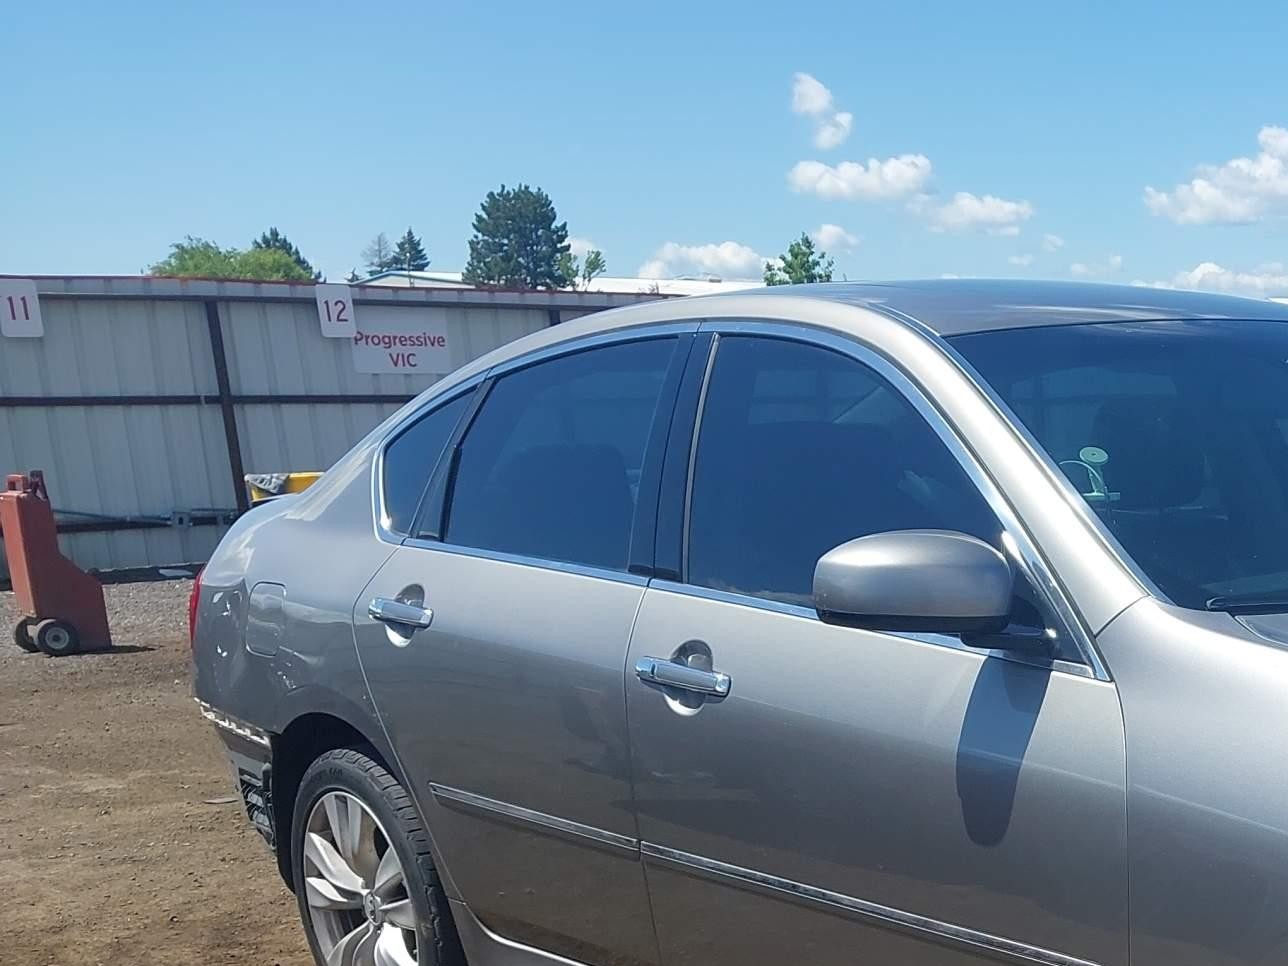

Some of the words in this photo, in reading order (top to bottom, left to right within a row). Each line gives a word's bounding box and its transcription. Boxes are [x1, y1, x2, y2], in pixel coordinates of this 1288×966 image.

[6, 295, 30, 321] 11
[324, 299, 349, 323] 12
[354, 331, 446, 349] Progressive
[389, 352, 418, 368] VIC
